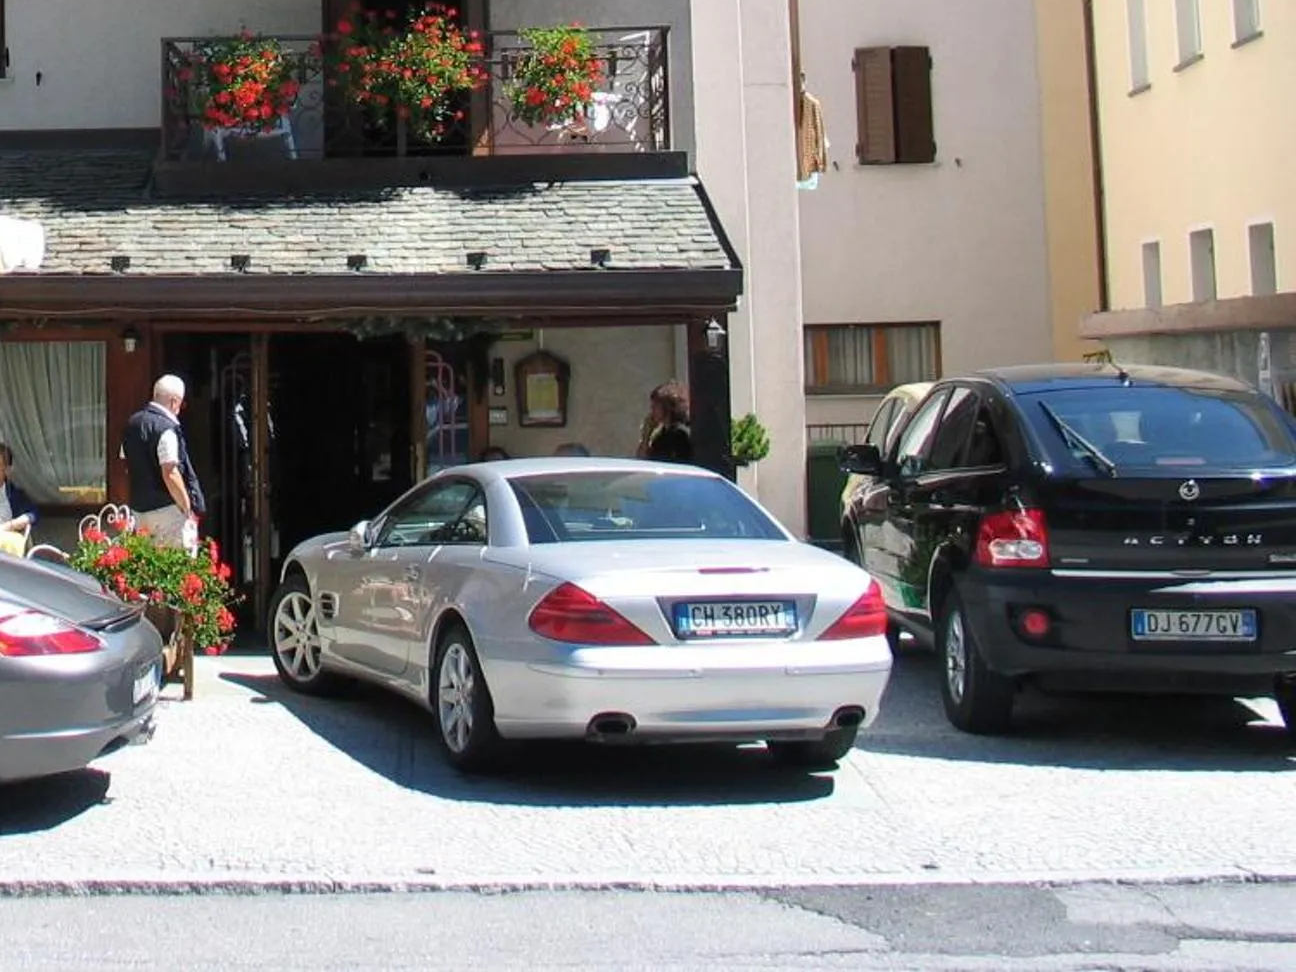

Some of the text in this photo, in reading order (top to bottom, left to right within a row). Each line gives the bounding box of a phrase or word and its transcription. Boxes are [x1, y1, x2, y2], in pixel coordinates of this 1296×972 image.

[691, 604, 783, 628] CH 380RY
[1147, 613, 1241, 634] DJ 677GV
